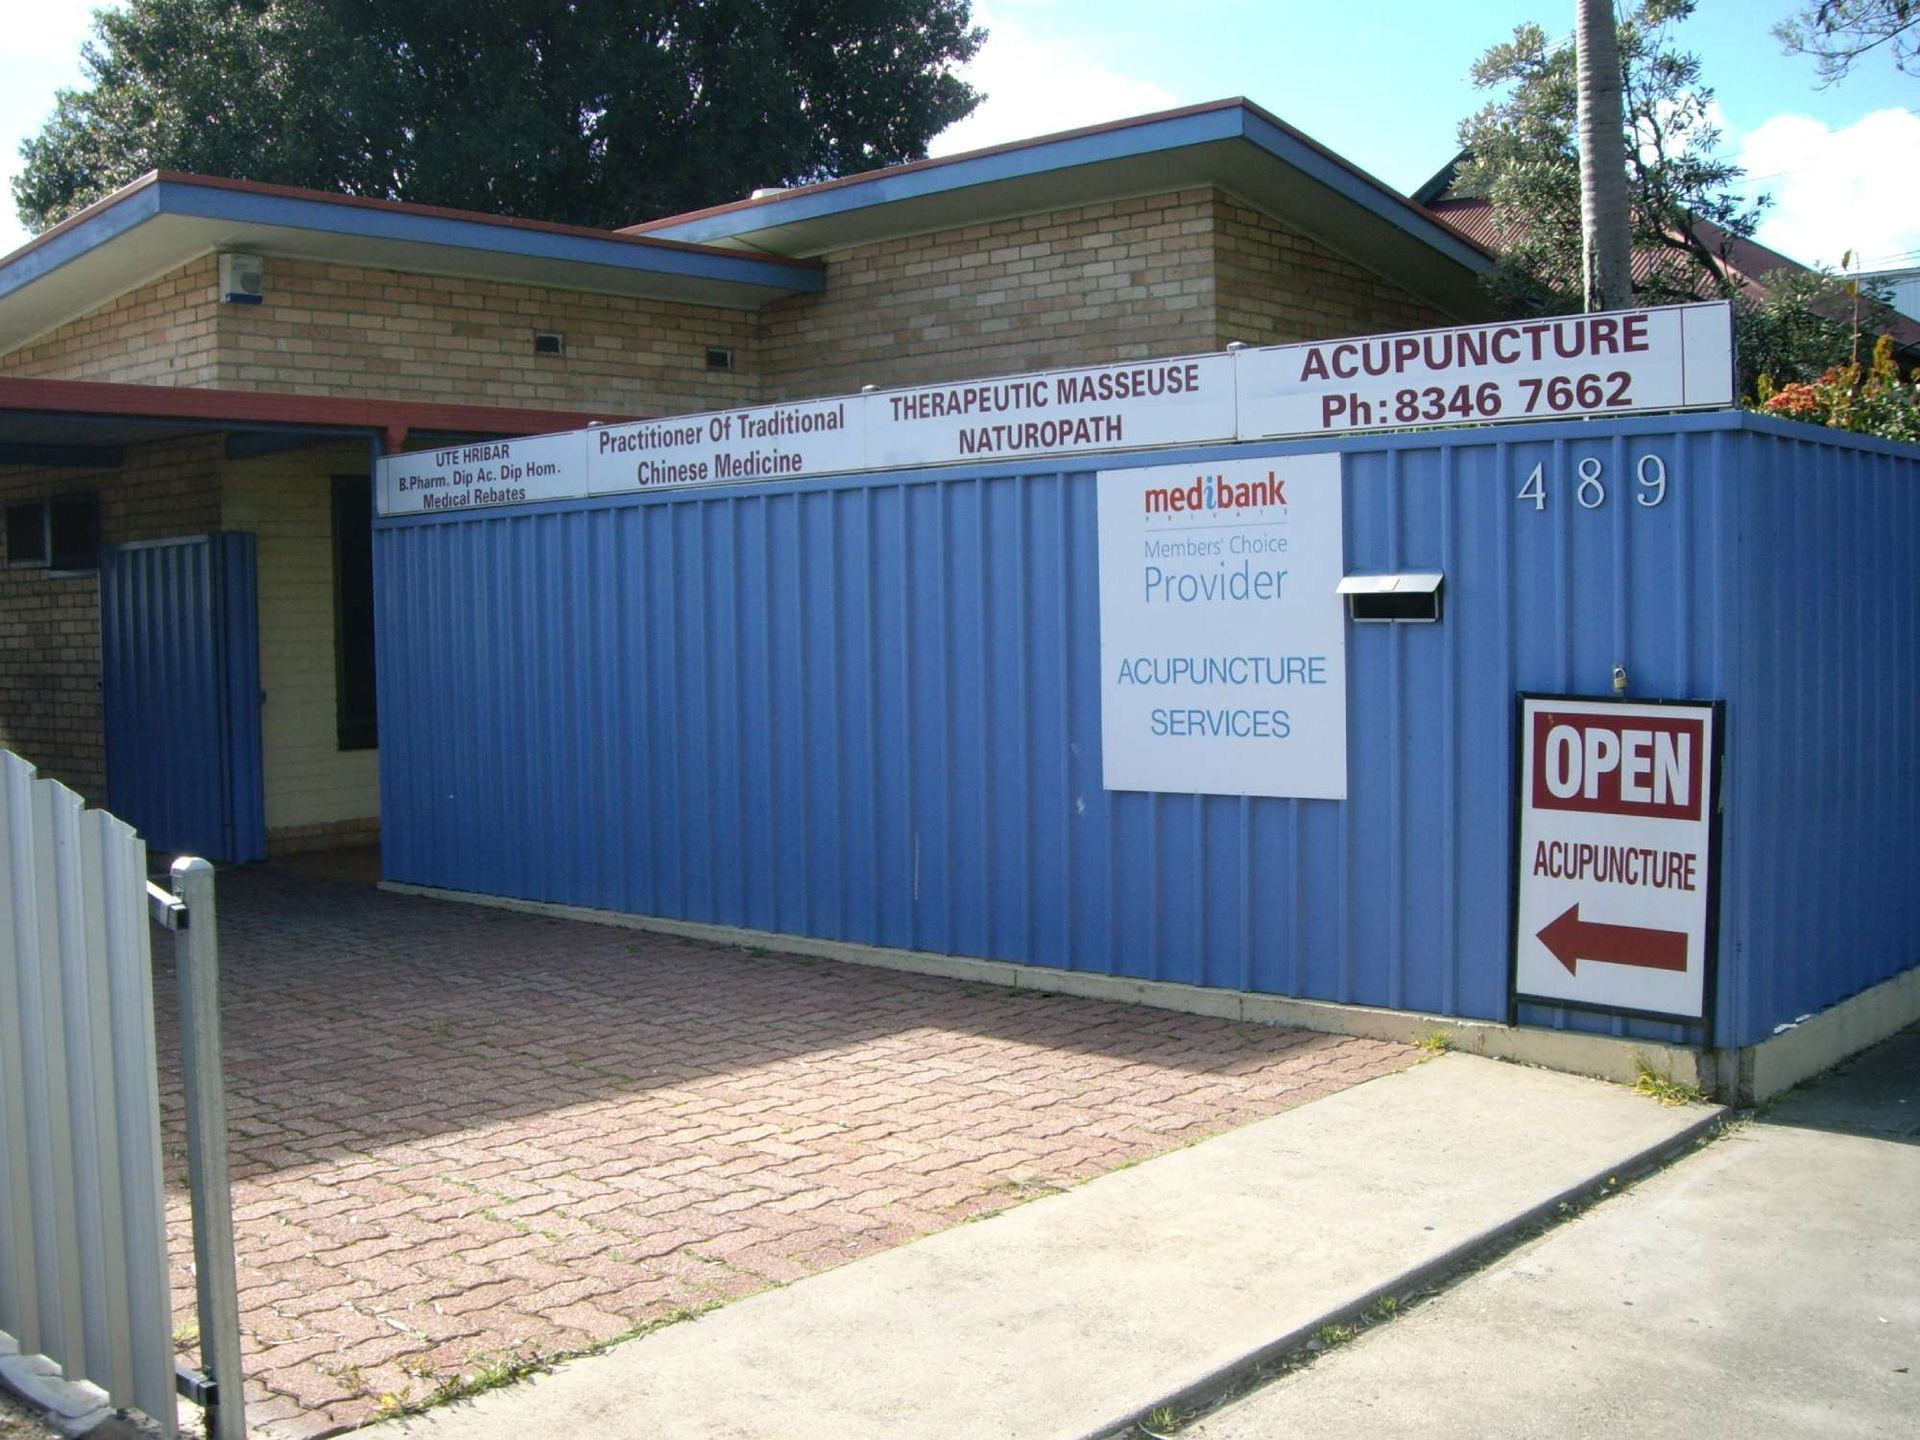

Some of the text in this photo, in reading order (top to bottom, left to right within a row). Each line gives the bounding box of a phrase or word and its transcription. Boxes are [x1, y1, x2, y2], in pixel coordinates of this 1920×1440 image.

[1300, 314, 1650, 382] ACUPUNCTURE
[889, 364, 1200, 421] THERAPEUTIC MASSEUSE
[1518, 371, 1634, 413] 7662
[599, 403, 845, 454] Practitioner Of Traditional
[958, 414, 1123, 454] NATUROPATH
[436, 444, 510, 467] UTE HRIBAR
[453, 470, 474, 488] Dip
[477, 467, 498, 482] Ac.
[501, 464, 523, 482] Dip
[526, 461, 561, 477] Hom.
[637, 449, 803, 486] Chinese Medicine
[423, 486, 526, 510] Medical Rebates
[1145, 471, 1288, 513] medibank
[1144, 533, 1288, 559] Members' Choice
[1145, 560, 1289, 602] Provider
[1117, 657, 1327, 684] ACUPUNCTURE
[1150, 709, 1291, 738] SERVICES
[1544, 724, 1690, 807] OPEN
[1532, 840, 1697, 892] ACUPUNCTURE
